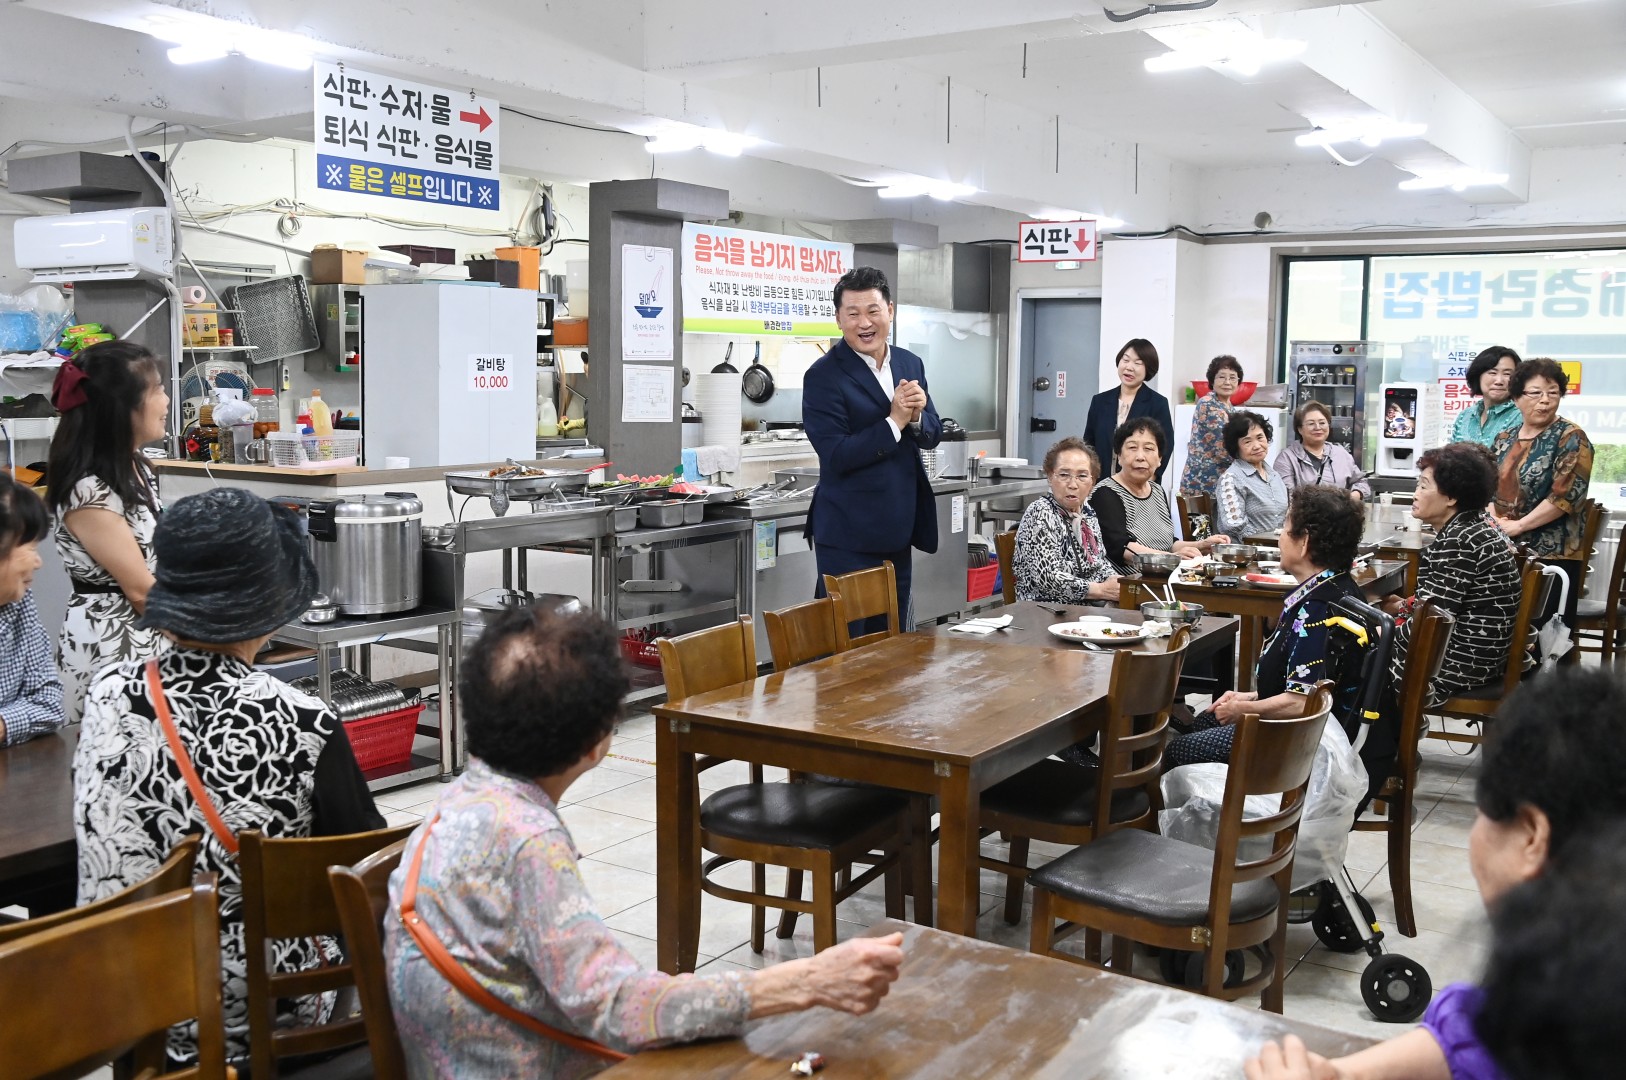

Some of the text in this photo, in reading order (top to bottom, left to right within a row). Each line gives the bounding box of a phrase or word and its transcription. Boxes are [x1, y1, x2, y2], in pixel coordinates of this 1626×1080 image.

[324, 115, 368, 152] 퇴식
[348, 164, 385, 193] 물은
[389, 171, 474, 204] 셀프입니다
[1024, 227, 1072, 255] 식판
[694, 233, 745, 266] 음식을
[750, 240, 796, 271] 남기지
[740, 271, 753, 280] away
[754, 271, 763, 279] the
[763, 272, 774, 280] food
[709, 281, 731, 295] 식자재
[733, 283, 739, 296] 및
[741, 284, 762, 297] 난방비
[764, 285, 790, 299] 급등으로
[791, 288, 804, 301] 힘든
[701, 297, 724, 311] 음식을
[726, 300, 739, 312] 남길
[742, 300, 749, 312] 시
[750, 301, 790, 315] 환경부담금을
[791, 303, 810, 316] 적용할
[812, 305, 818, 316] 수
[476, 358, 506, 371] 갈비탕
[473, 376, 509, 389] 10,000
